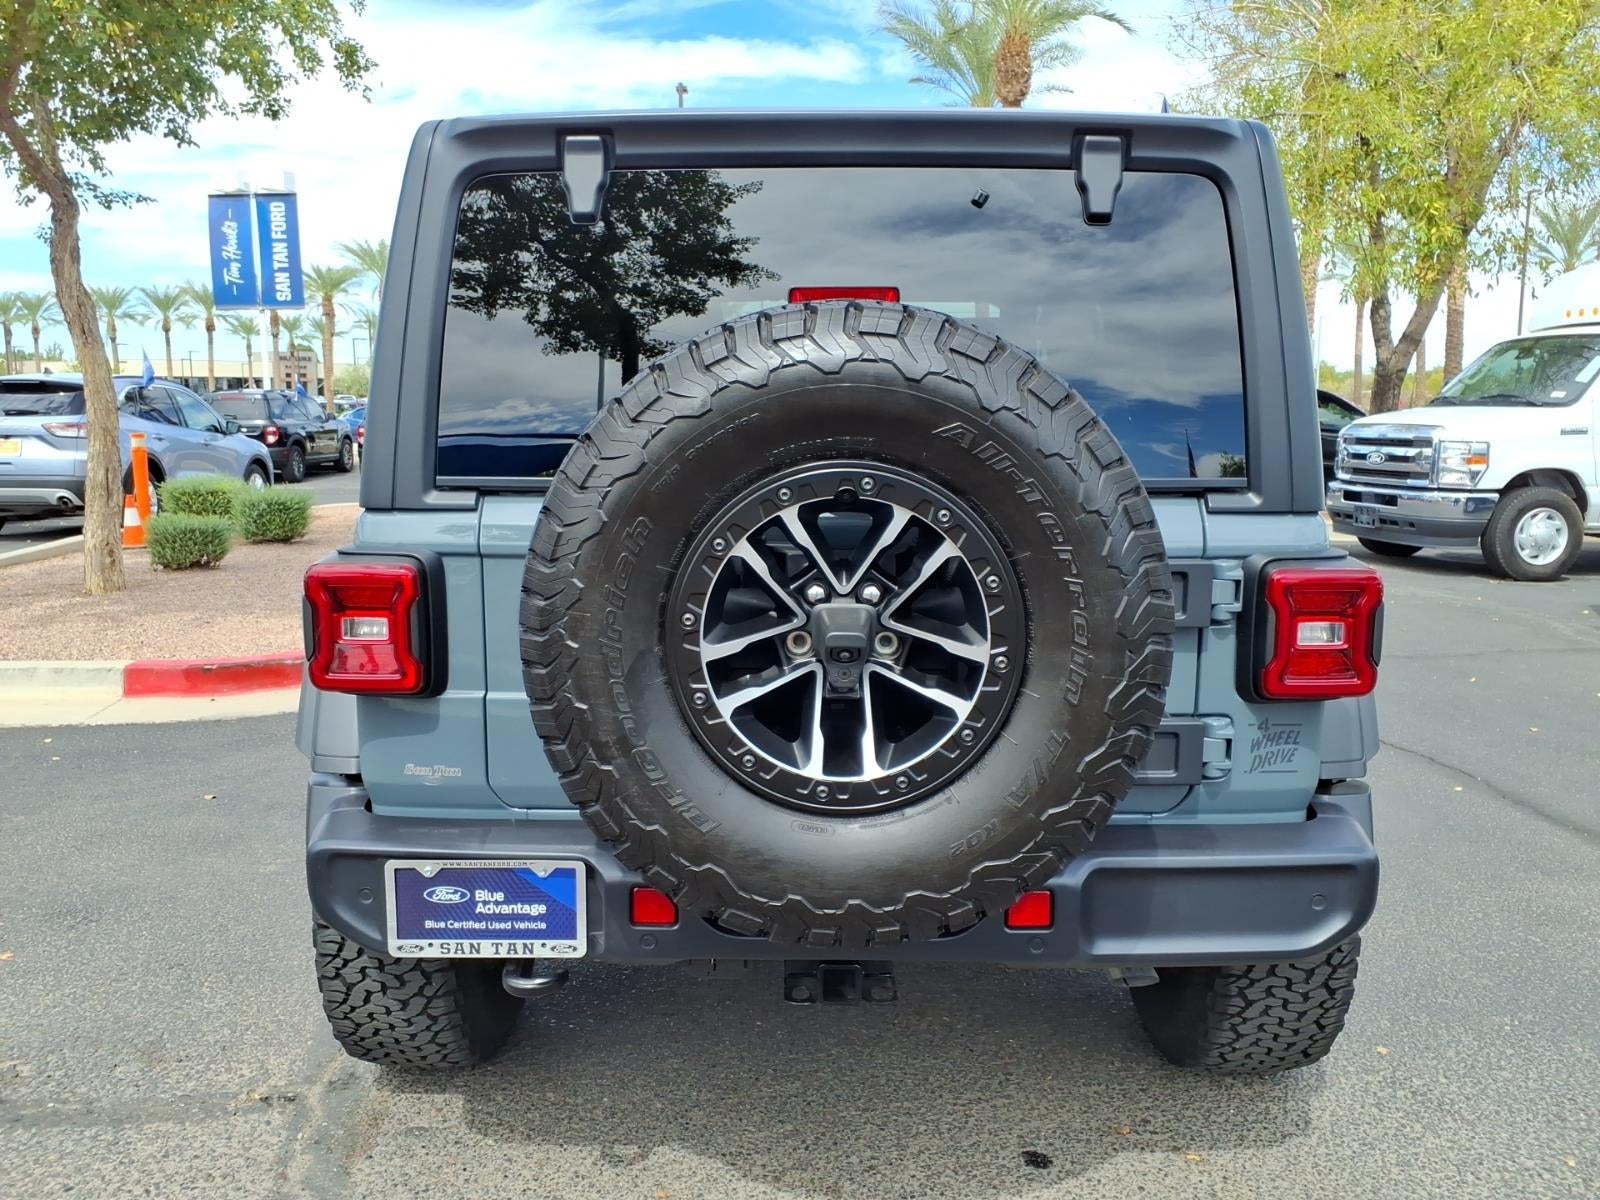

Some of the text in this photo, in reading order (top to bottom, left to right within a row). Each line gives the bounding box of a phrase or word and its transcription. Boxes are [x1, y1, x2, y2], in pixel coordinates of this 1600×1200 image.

[269, 201, 292, 302] SAN TAN FORD
[223, 262, 244, 286] Tim
[931, 422, 1090, 707] All-Terrain
[598, 515, 722, 836] BFGoodrich
[1250, 730, 1300, 754] WHEEL
[1248, 748, 1298, 774] DRIVE
[431, 887, 463, 902] Ford
[475, 889, 505, 901] Blue
[475, 903, 547, 916] Advantage
[425, 920, 547, 930] Blue Certified Used Vehicle
[440, 942, 535, 955] SAN TAN
